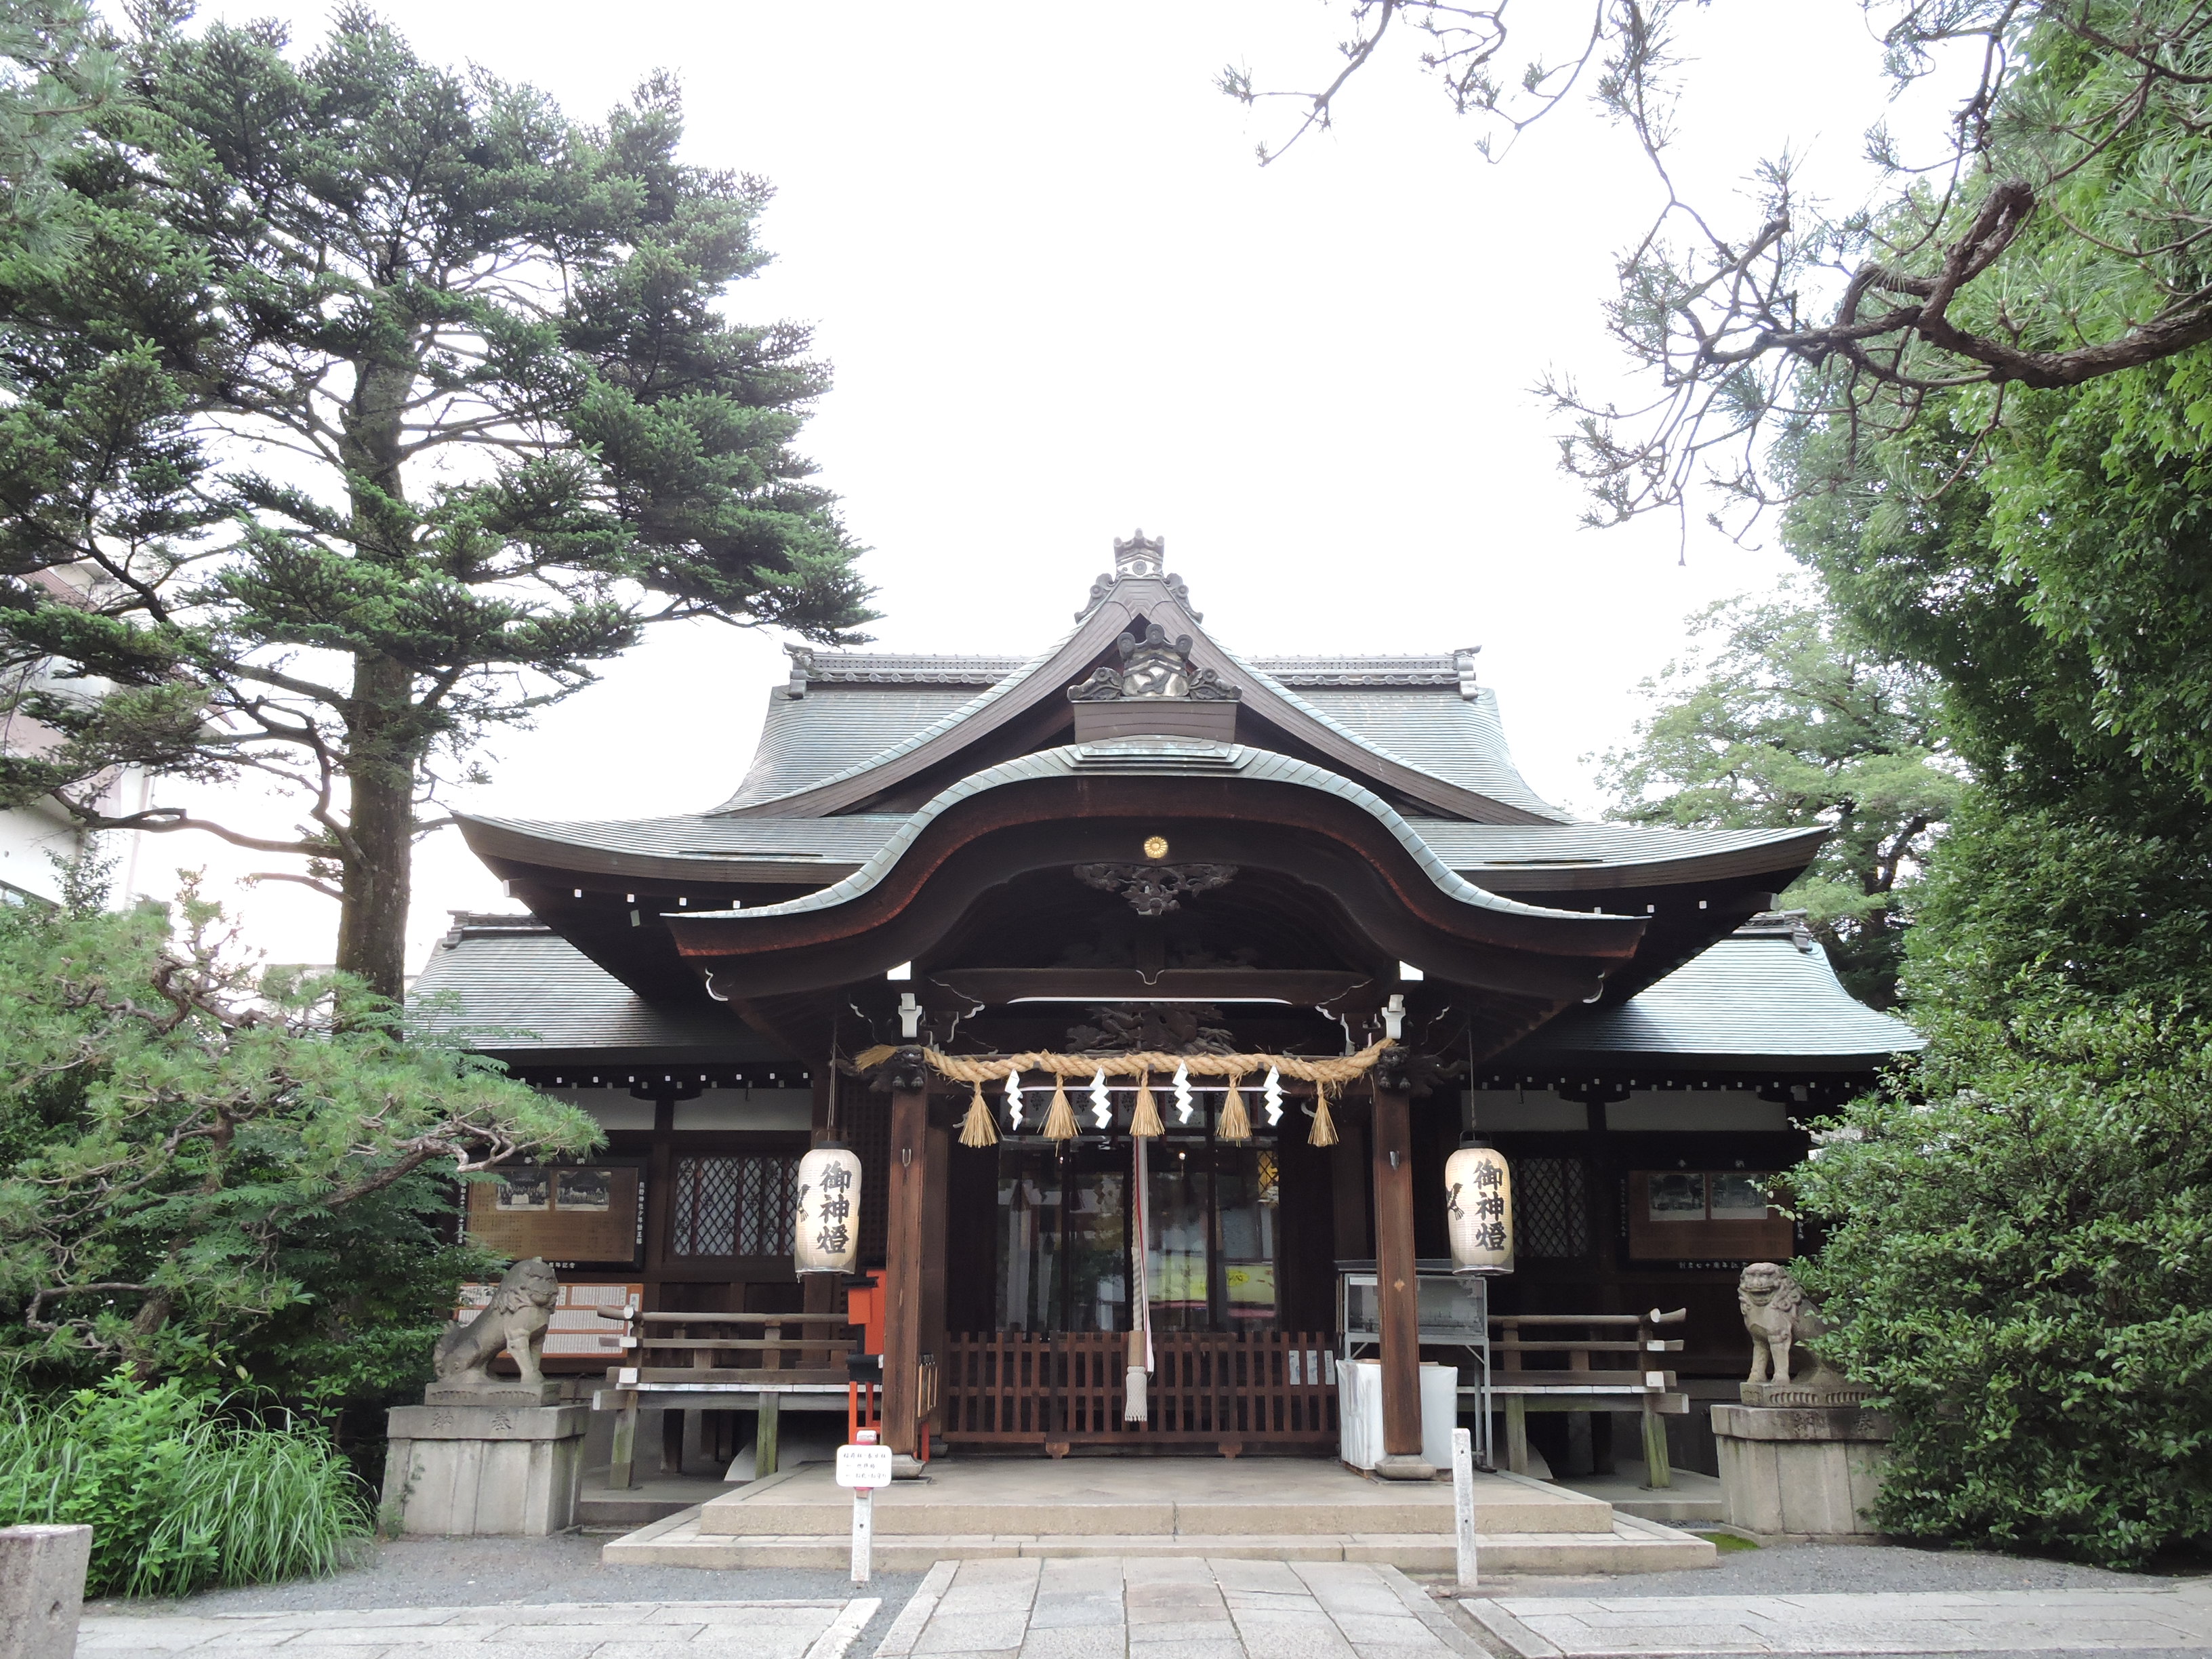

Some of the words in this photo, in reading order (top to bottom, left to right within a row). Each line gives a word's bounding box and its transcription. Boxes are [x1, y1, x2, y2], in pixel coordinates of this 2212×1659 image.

[816, 1160, 853, 1254] 御神燈
[1473, 1158, 1507, 1252] 御神燈
